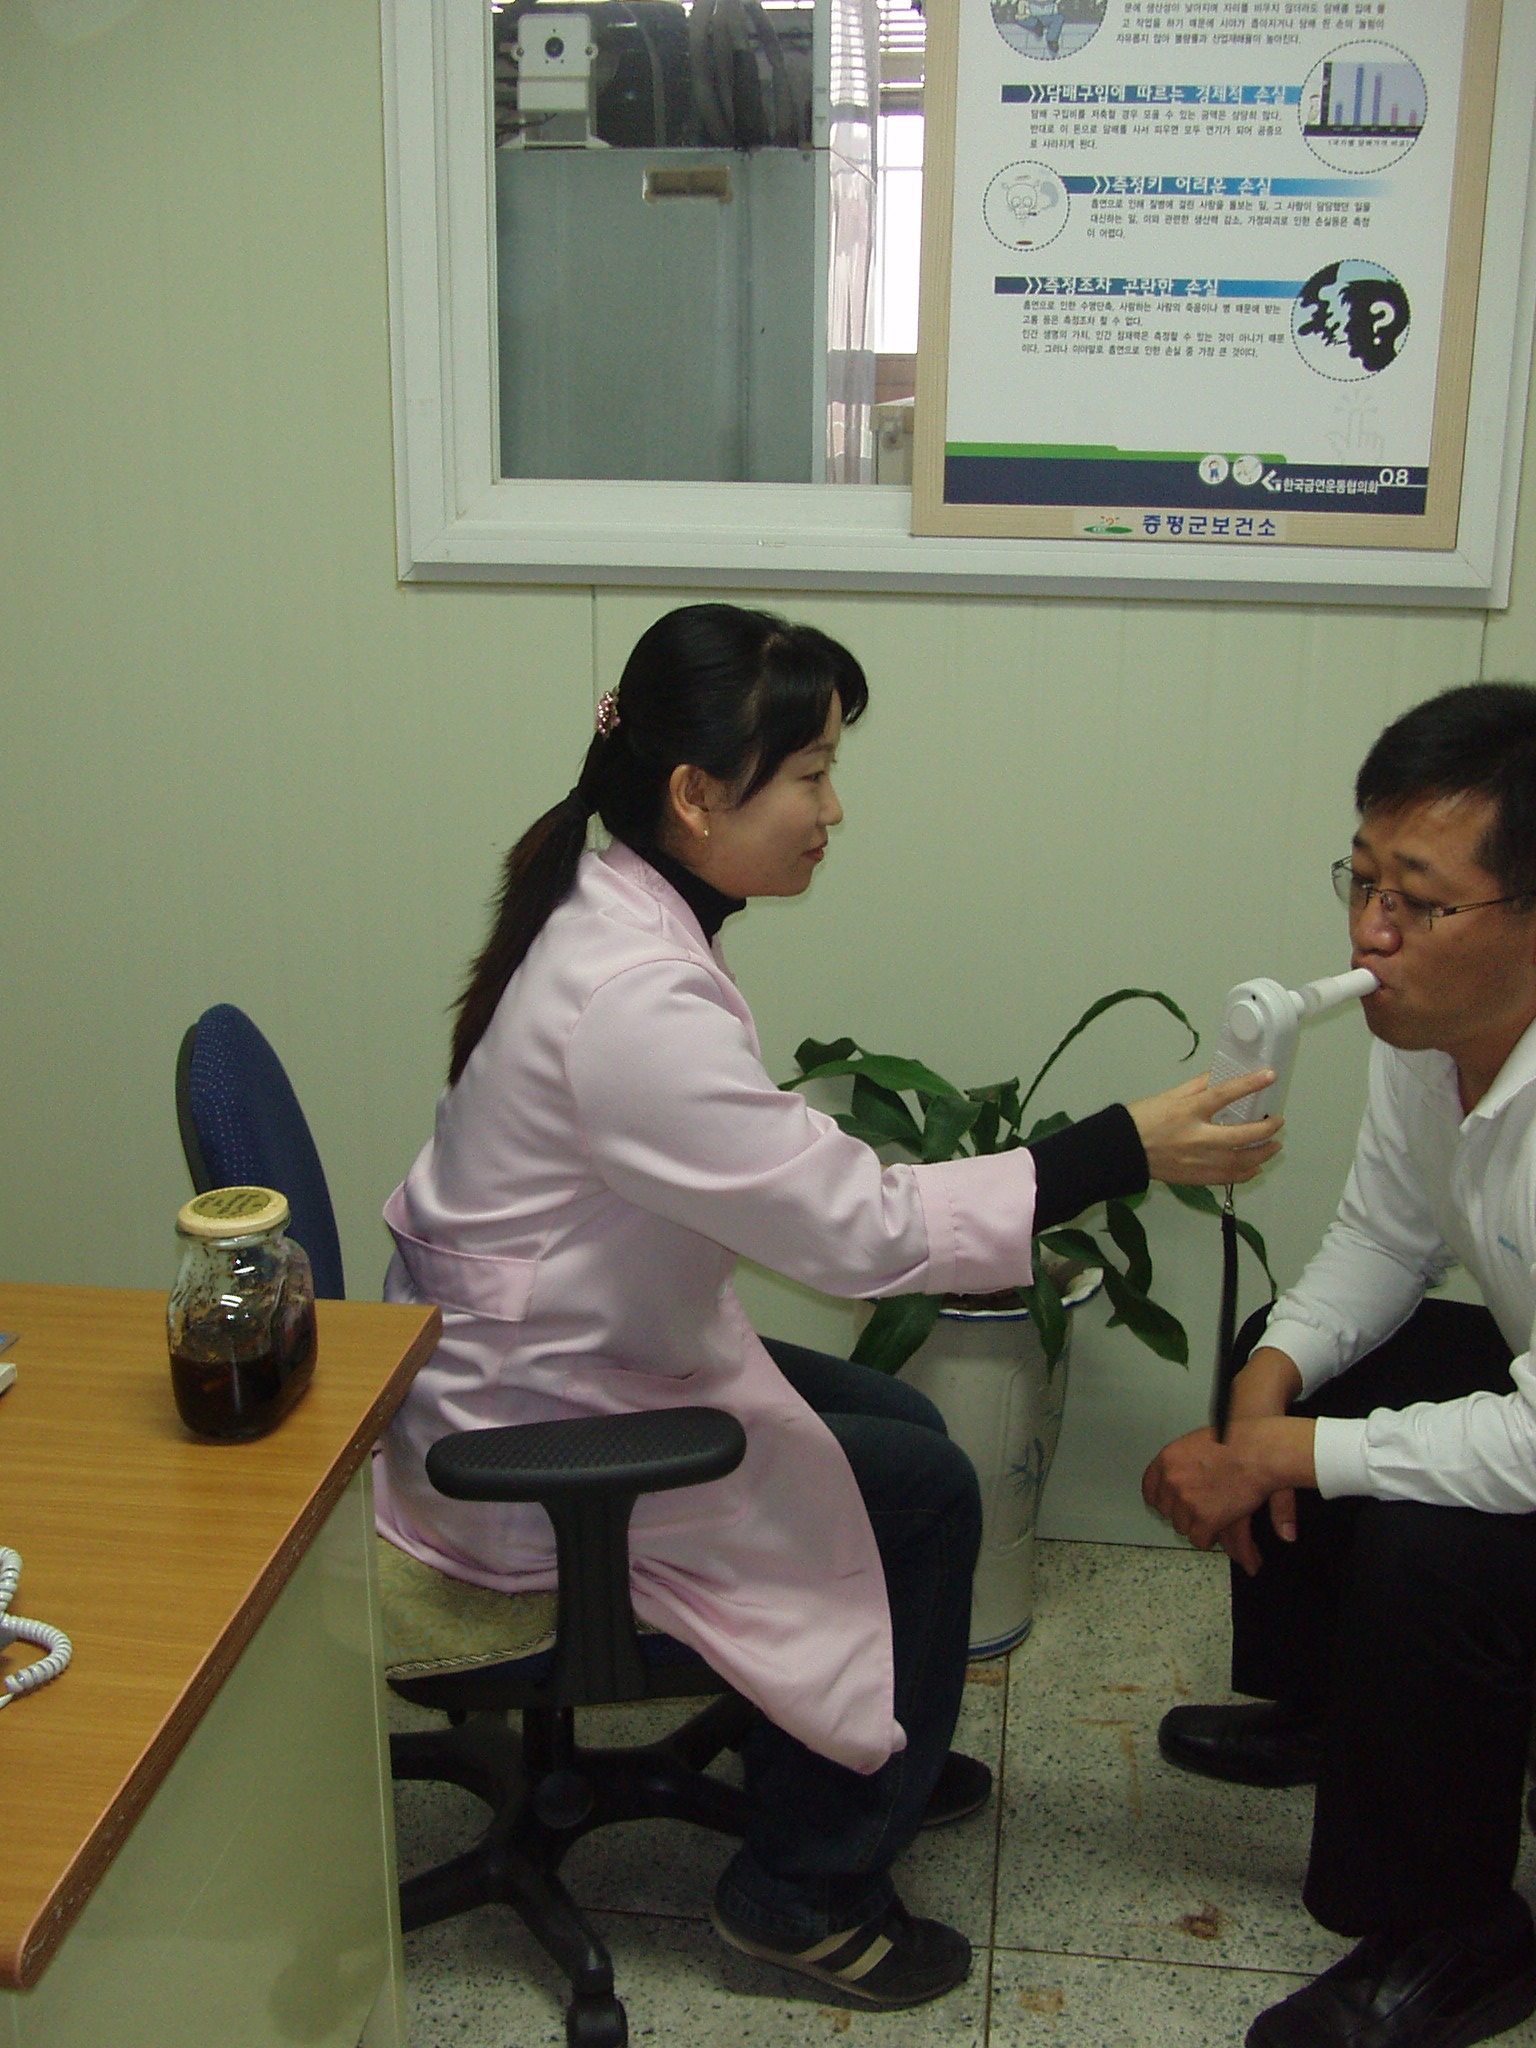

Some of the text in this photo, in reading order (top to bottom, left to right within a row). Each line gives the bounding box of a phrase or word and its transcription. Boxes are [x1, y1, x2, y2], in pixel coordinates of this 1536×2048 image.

[1047, 85, 1285, 104] 담배구입에 따르는 경제적 손실
[1031, 109, 1047, 120] 담배
[1122, 109, 1138, 120] 경우
[1165, 110, 1174, 121] 수
[1180, 110, 1195, 121] 있는
[1030, 124, 1054, 134] 반대로
[1060, 124, 1068, 134] 이
[1103, 125, 1126, 135] 담배를
[1133, 125, 1148, 135] 사서
[1043, 139, 1074, 149] 사라지게
[1175, 177, 1226, 196] 어려운
[1238, 177, 1271, 196] 손실
[1091, 199, 1123, 209] 흡연으로
[1274, 201, 1282, 211] 그
[1287, 201, 1311, 211] 사람이
[1091, 214, 1122, 224] 대신하는
[1087, 228, 1095, 239] 이
[1043, 277, 1112, 295] 측정조차
[1185, 279, 1217, 297] 손실
[1023, 300, 1055, 311] 흡연으로
[1060, 301, 1076, 312] 인한
[1022, 315, 1038, 326] 고통
[1112, 316, 1120, 327] 수
[1022, 330, 1038, 340] 인간
[1096, 331, 1112, 341] 인간
[1183, 332, 1191, 342] 수
[1045, 345, 1067, 355] 그러나
[1379, 468, 1409, 487] 08
[1283, 476, 1378, 494] 한국금연운동협의회
[1143, 514, 1276, 537] 증평군보건소
